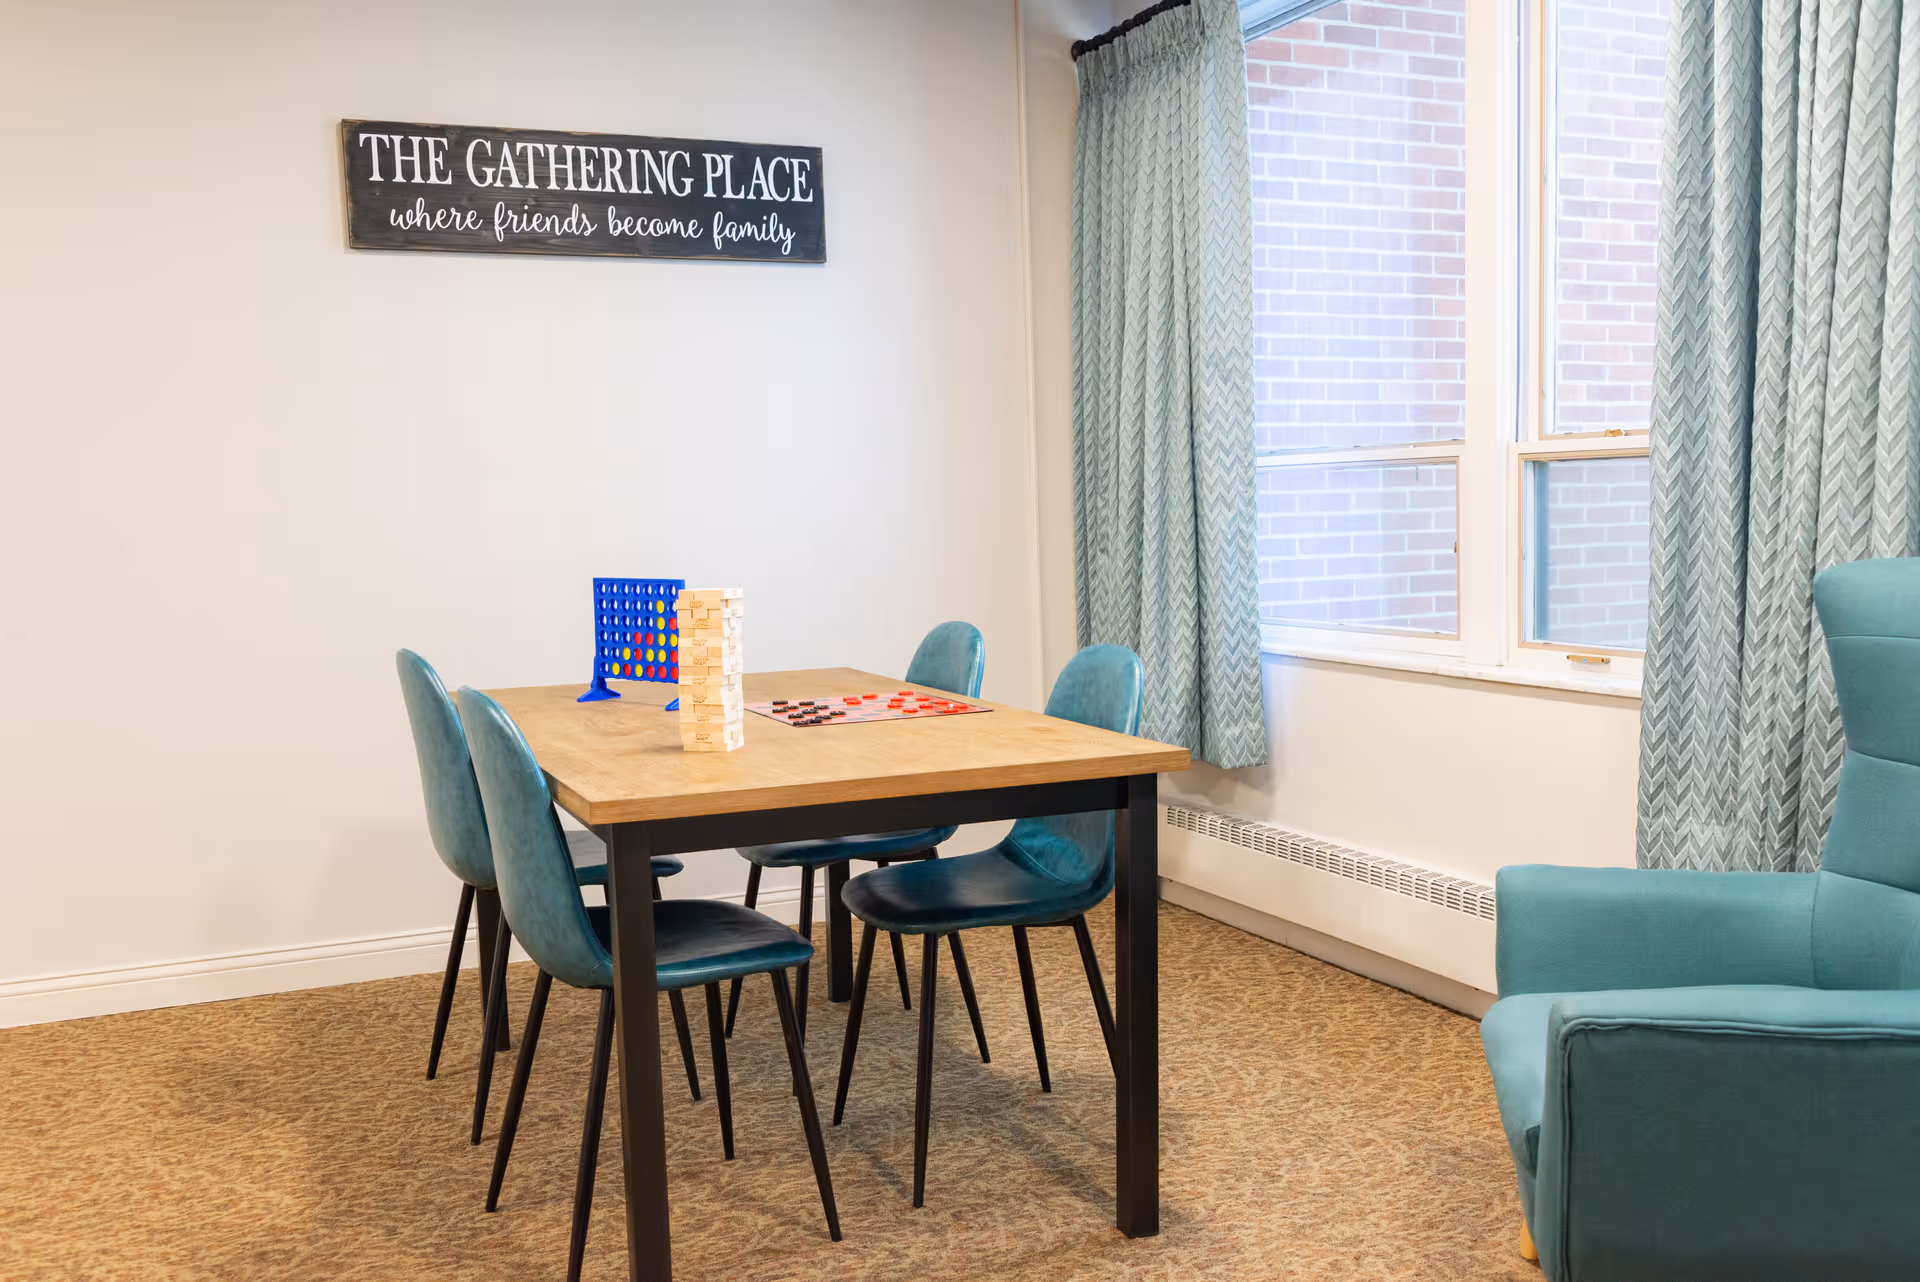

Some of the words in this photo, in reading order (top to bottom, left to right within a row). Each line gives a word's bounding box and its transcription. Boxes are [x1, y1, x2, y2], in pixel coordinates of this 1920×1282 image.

[359, 133, 453, 185] THE
[465, 138, 695, 197] GATHERING
[702, 152, 814, 203] PLACE
[389, 197, 484, 232] where
[493, 201, 598, 243] friends
[607, 205, 704, 239] become
[712, 211, 796, 256] family
